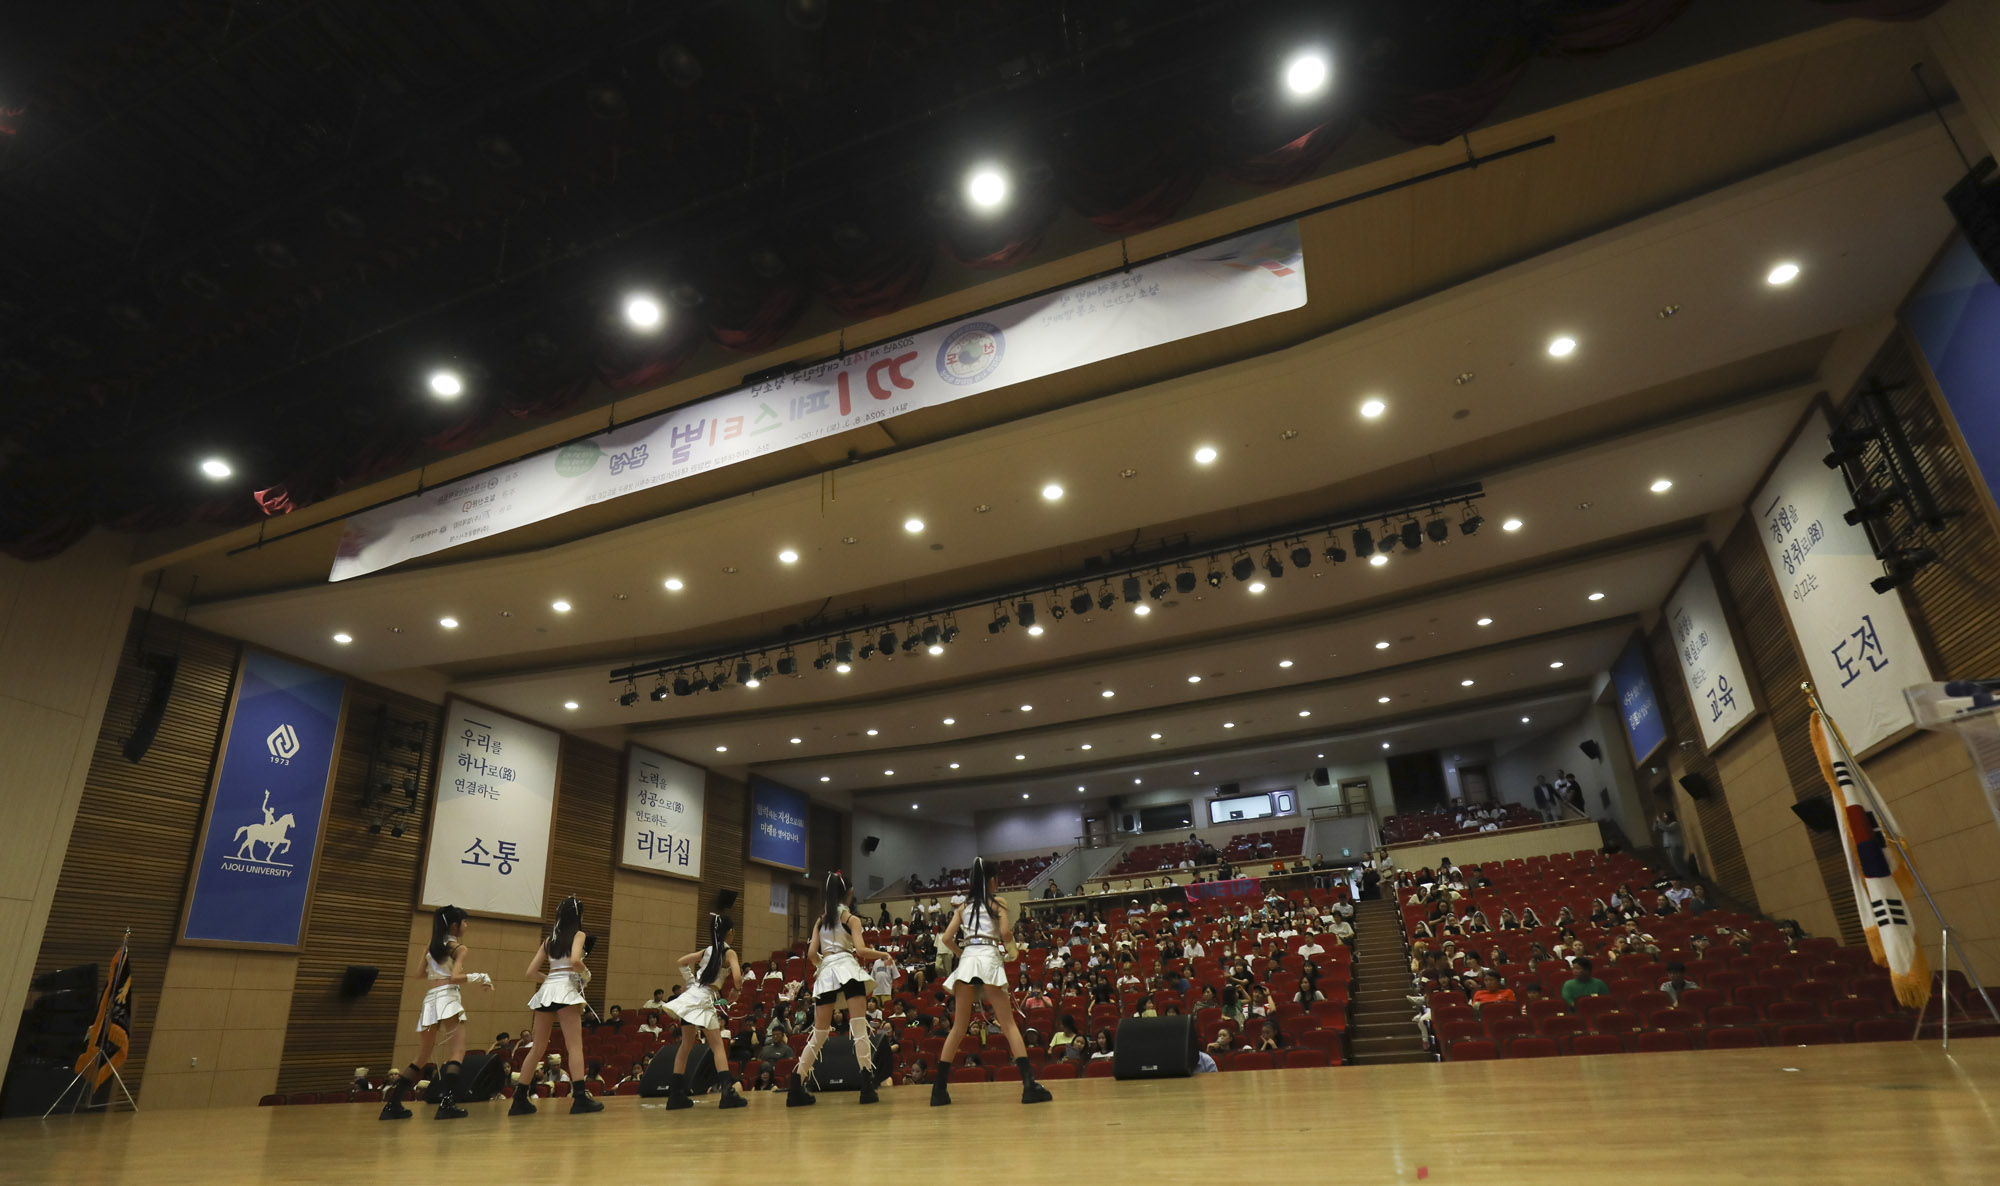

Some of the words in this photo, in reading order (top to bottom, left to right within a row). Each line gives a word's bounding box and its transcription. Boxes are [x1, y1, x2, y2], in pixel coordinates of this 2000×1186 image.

[1769, 504, 1800, 544] 경험을
[1793, 573, 1819, 603] 이끄는
[1830, 614, 1890, 689] 도전
[1706, 674, 1737, 723] 교육
[460, 728, 503, 755] 우리를
[269, 756, 290, 766] 1973
[457, 753, 516, 782] 하나로(路)
[454, 778, 501, 801] 연결하는
[638, 769, 668, 791] 노력을
[636, 810, 668, 828] 인도하는
[760, 822, 777, 838] 미래를
[461, 836, 520, 876] 소통
[637, 829, 690, 867] 리더십
[220, 862, 245, 872] AJOU
[246, 864, 293, 878] UNIVERSITY
[1190, 882, 1227, 898] LINE
[1231, 880, 1254, 896] UP
